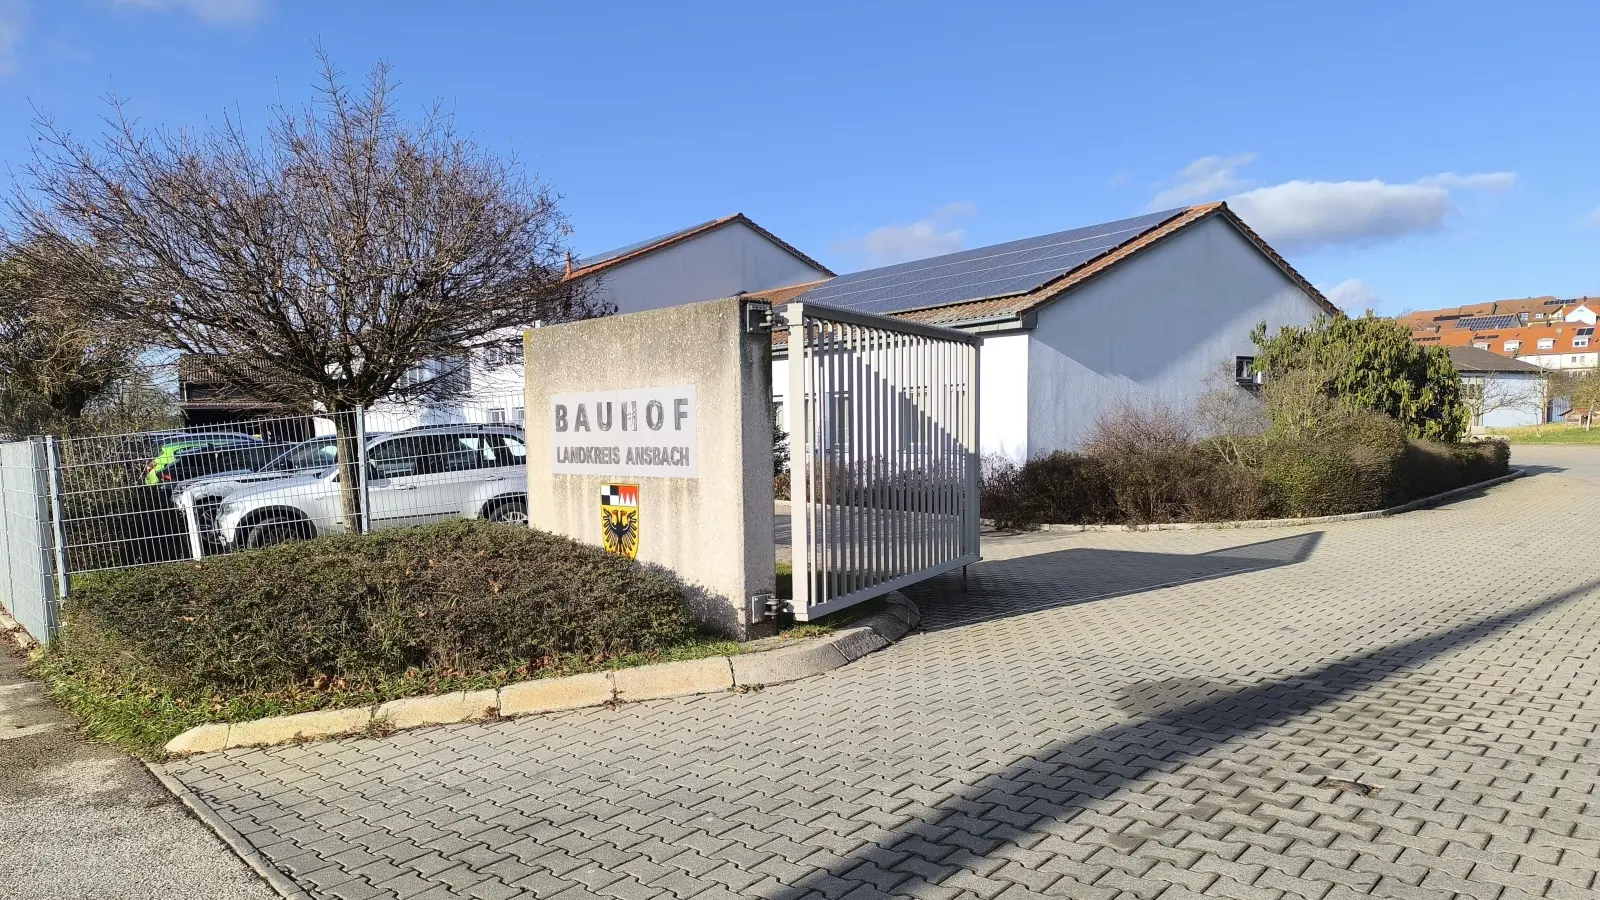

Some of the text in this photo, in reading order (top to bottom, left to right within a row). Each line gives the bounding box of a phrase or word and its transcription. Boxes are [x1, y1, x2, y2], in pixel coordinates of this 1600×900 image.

[555, 398, 688, 432] BAUHOF
[556, 446, 690, 466] LANDKREIS ANSBACH
